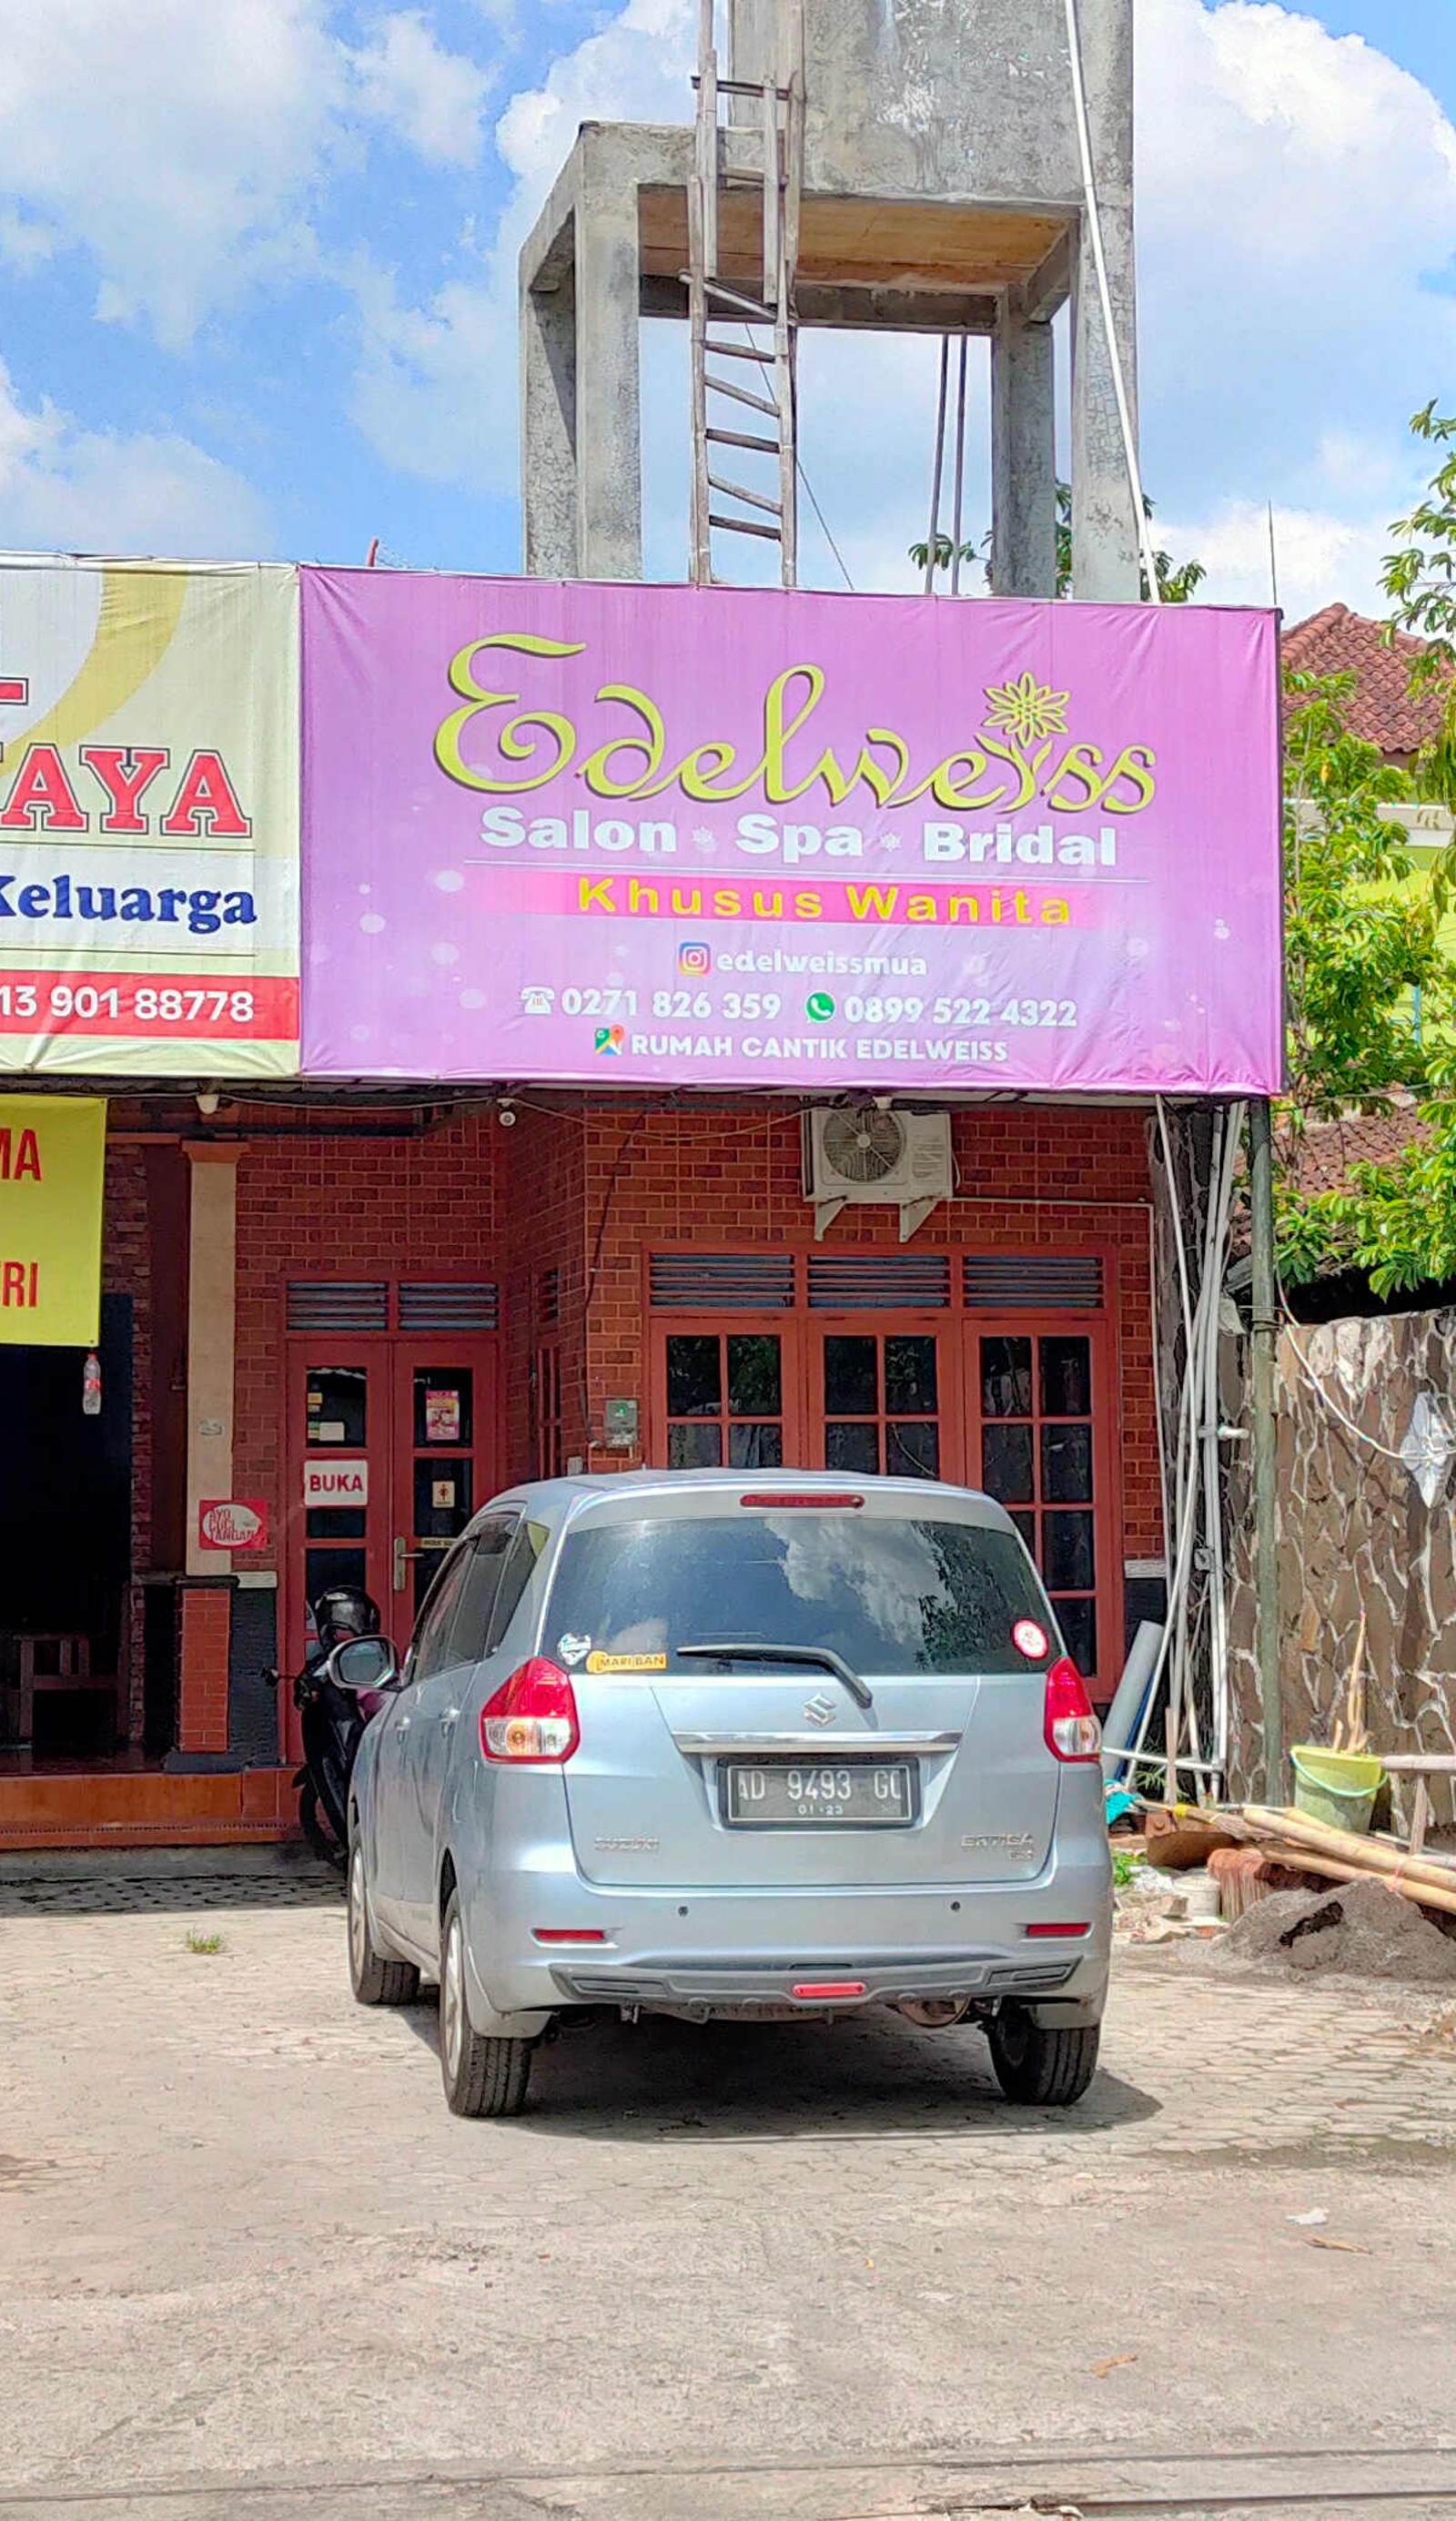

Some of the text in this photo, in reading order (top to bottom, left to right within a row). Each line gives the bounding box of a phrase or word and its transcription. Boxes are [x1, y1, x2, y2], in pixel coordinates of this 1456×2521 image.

[434, 633, 1158, 814] Edelweiss
[0, 742, 253, 838] AYA
[480, 805, 1117, 866] Salon Spa Bridal
[578, 876, 1071, 926] Khusus Wanita
[716, 949, 927, 976] edelweissmua
[50, 986, 118, 1018] 901
[134, 987, 255, 1022] 88778
[561, 987, 1077, 1028] 0271 826 359 0899 522 4322
[631, 1034, 1009, 1062] RUMAH CANTIK EDELWEISS
[0, 1260, 38, 1308] RI
[309, 1473, 363, 1493] BUKA
[738, 1769, 765, 1800] AD
[788, 1769, 852, 1799] 9493
